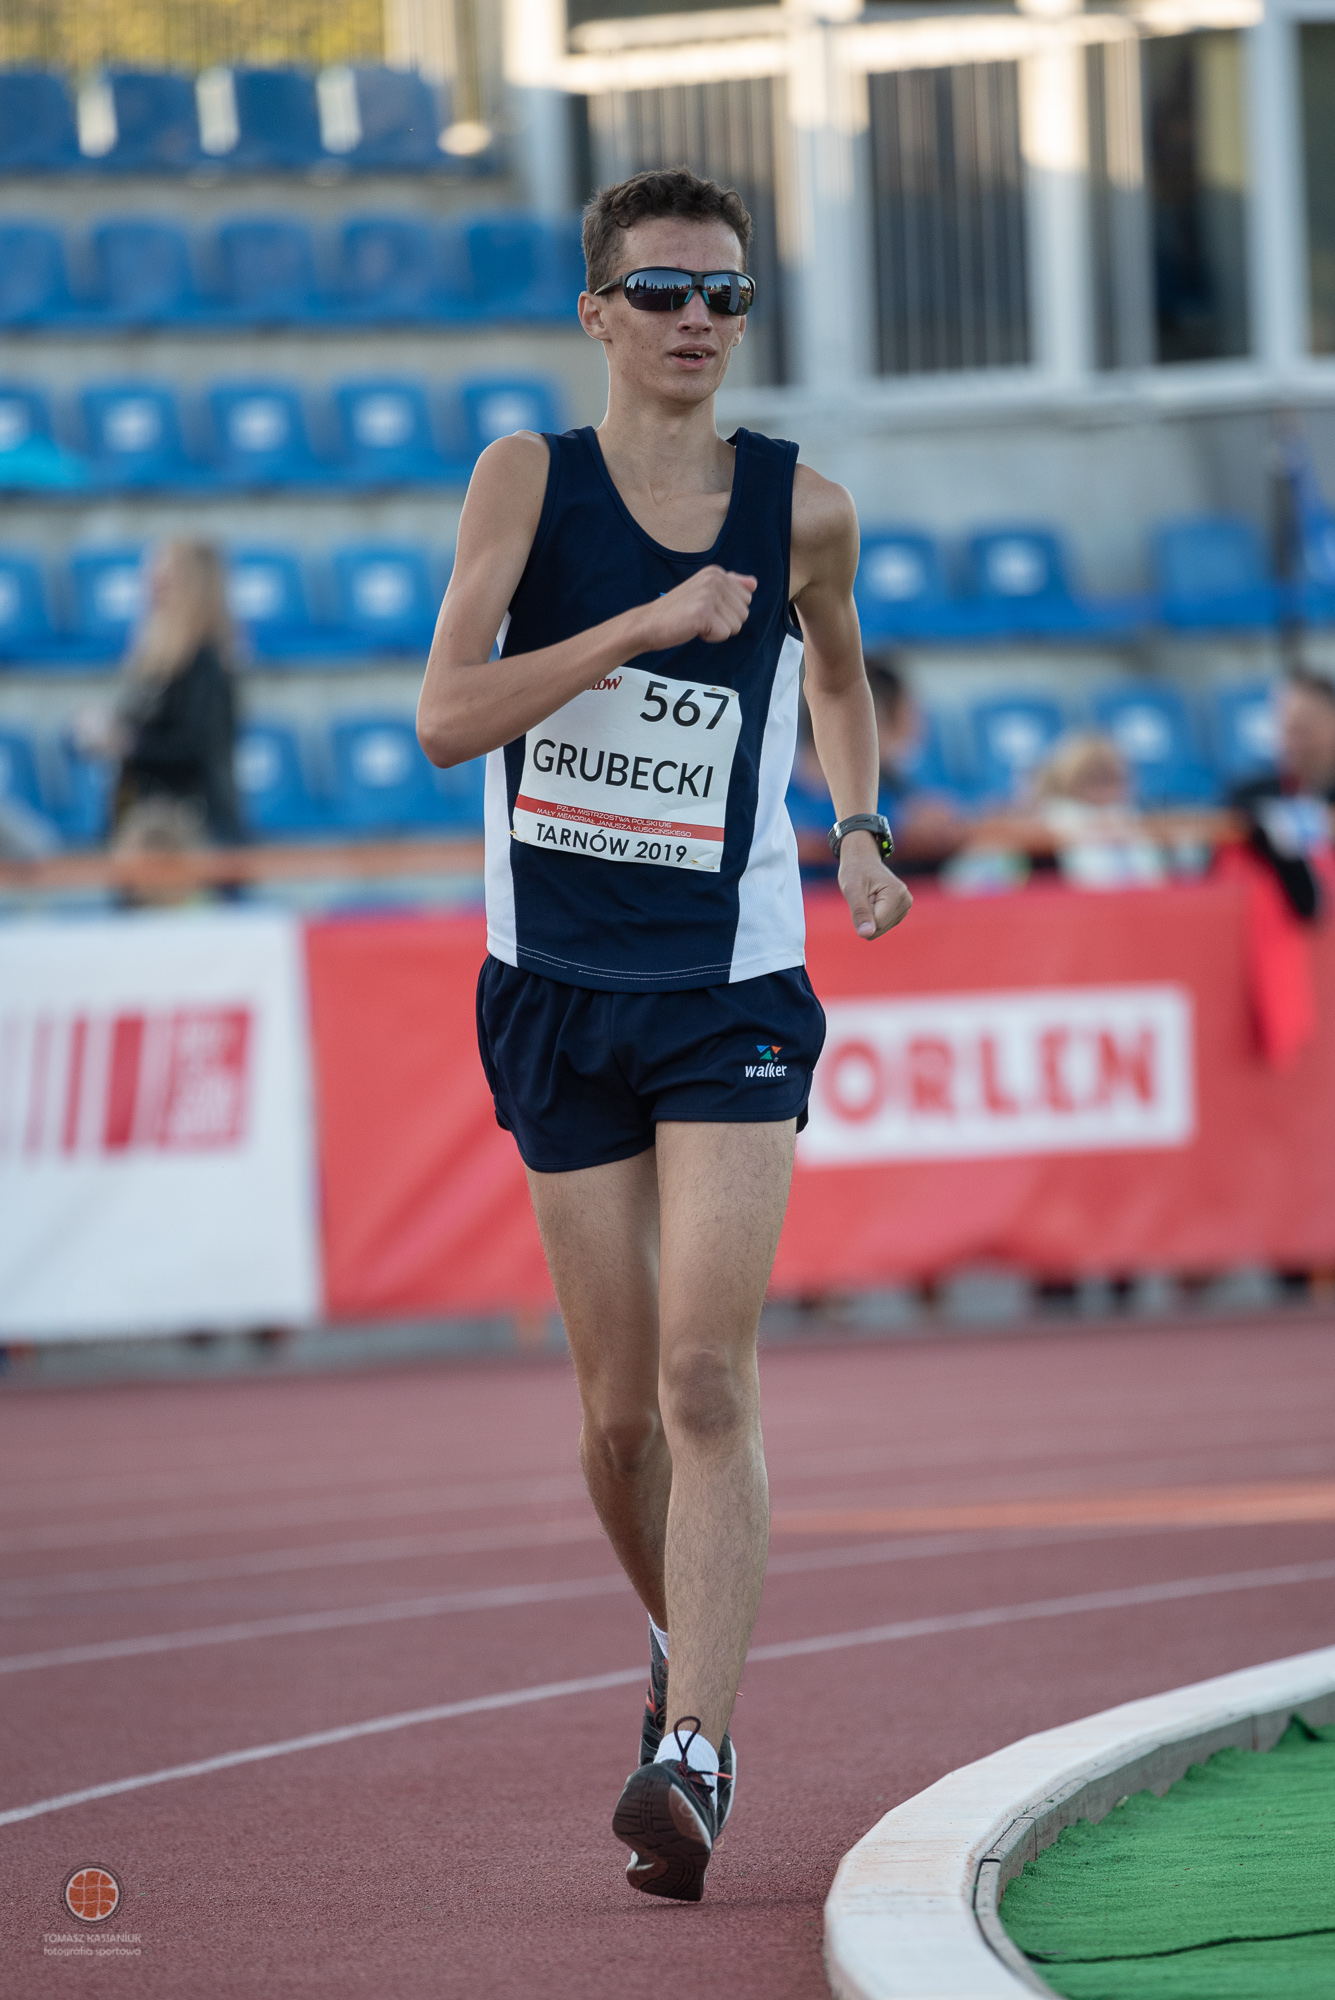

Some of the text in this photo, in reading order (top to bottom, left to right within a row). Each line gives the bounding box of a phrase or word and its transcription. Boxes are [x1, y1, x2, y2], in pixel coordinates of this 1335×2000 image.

[639, 680, 730, 730] 567
[532, 738, 714, 798] GRUBECKI
[536, 807, 556, 817] MAŁY
[556, 812, 596, 825] MEMORIAŁ
[596, 820, 632, 831] JANUSZA
[556, 804, 576, 813] PZLA
[577, 808, 630, 823] MISTRZOSTWA
[631, 818, 658, 827] POLSKI
[536, 822, 688, 863] TARNÓW 2019
[745, 1062, 788, 1078] walker
[821, 1022, 1155, 1127] ORLEN
